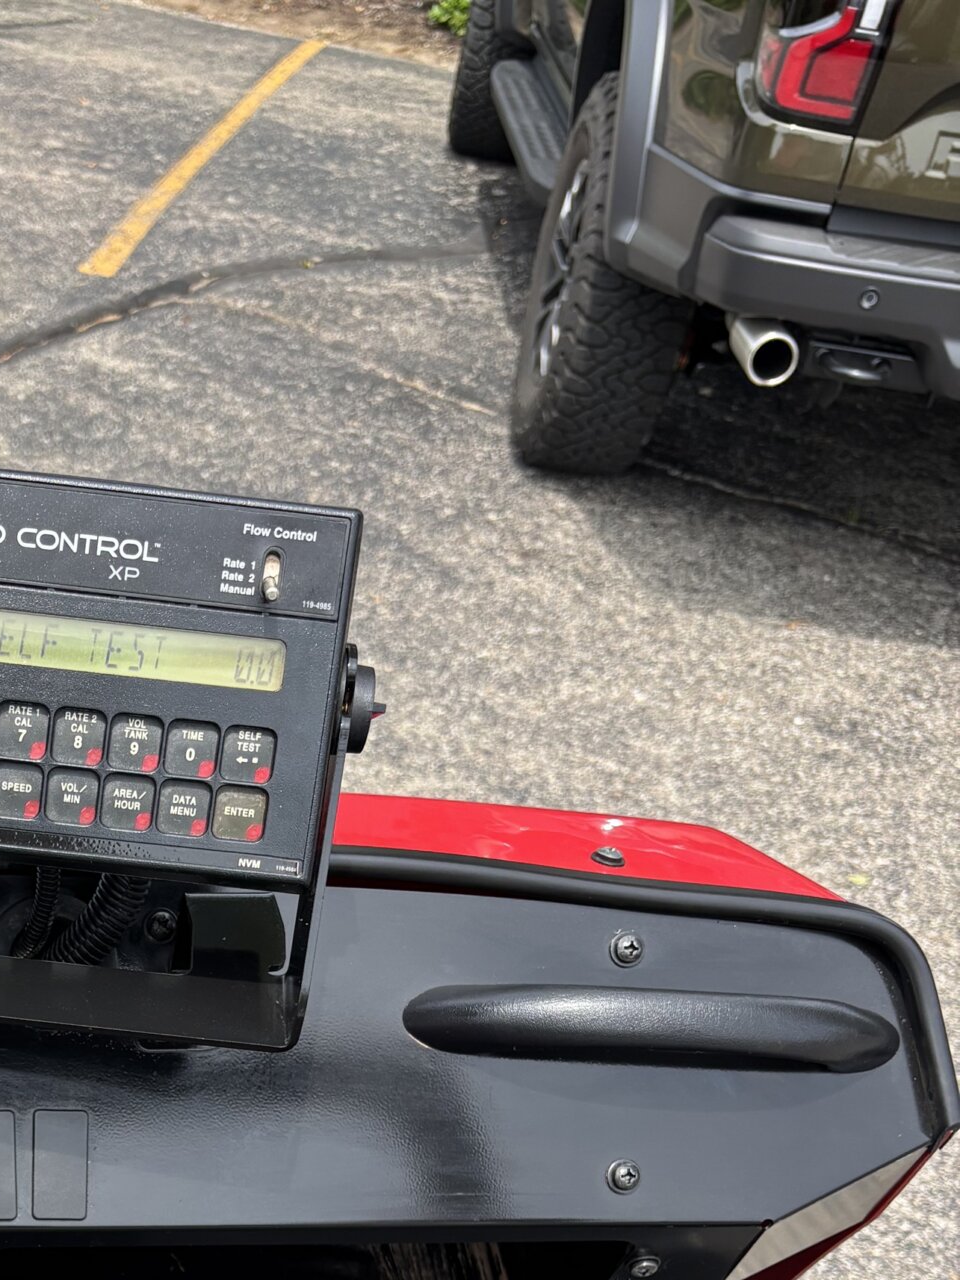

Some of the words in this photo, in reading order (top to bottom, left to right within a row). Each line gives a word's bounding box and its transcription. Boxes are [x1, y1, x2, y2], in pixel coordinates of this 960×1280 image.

[243, 524, 271, 538] Flow
[273, 527, 318, 542] Control
[16, 527, 160, 563] CONTROL
[223, 558, 246, 569] Rate
[251, 560, 256, 570] 1
[108, 565, 140, 581] XP
[221, 570, 244, 582] Rate
[248, 572, 255, 583] 2
[220, 583, 255, 596] Manual
[302, 600, 332, 611] 119-4985
[91, 628, 166, 671] TEST
[8, 705, 32, 716] RATE
[35, 708, 39, 716] 1
[14, 716, 32, 727] CAL
[65, 711, 88, 722] RATE
[91, 715, 97, 723] 2
[71, 723, 88, 734] CAL
[128, 718, 147, 729] VOL
[18, 729, 27, 742] 7
[124, 729, 149, 741] TANK
[182, 730, 204, 741] TIME
[238, 730, 262, 742] SELF
[74, 736, 83, 749] 8
[129, 742, 138, 755] 9
[236, 742, 260, 753] TEST
[185, 748, 195, 761] 0
[1, 781, 32, 794] SPEED
[63, 793, 80, 804] MIN
[172, 795, 197, 806] DATA
[114, 799, 141, 811] HOUR
[170, 805, 196, 817] MENU
[224, 806, 255, 818] ENTER
[238, 858, 261, 869] NVM
